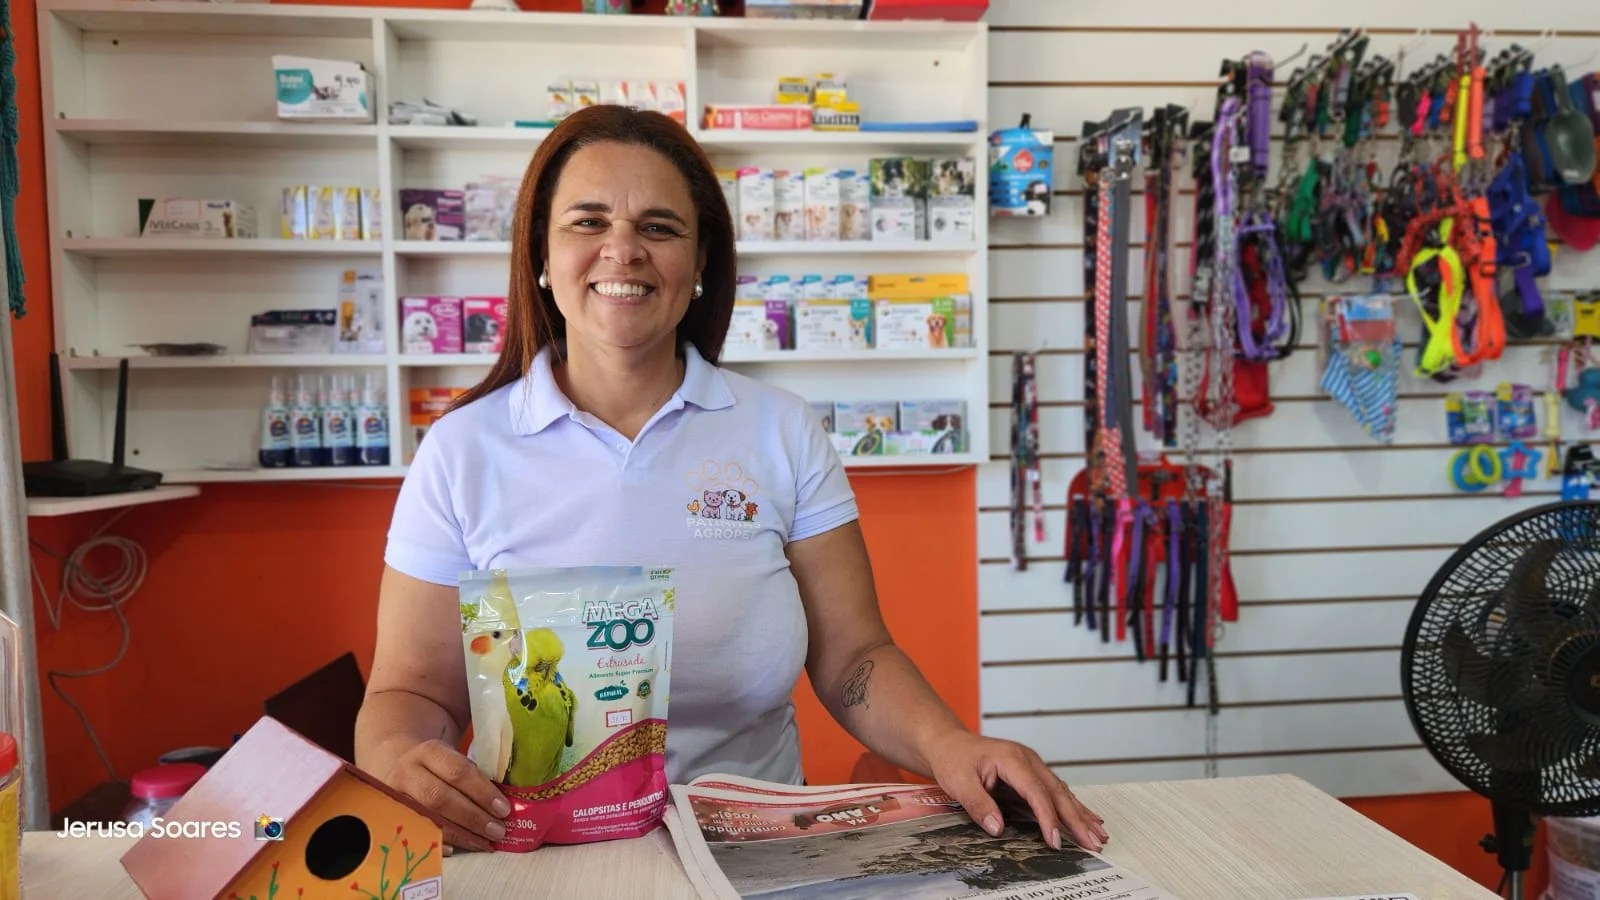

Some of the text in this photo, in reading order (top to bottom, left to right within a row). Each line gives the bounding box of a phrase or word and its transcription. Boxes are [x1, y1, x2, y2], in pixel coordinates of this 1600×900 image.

[581, 597, 659, 624] MEGA
[586, 618, 655, 652] ZOO
[572, 803, 621, 818] CALOPSITAS
[622, 802, 628, 811] E
[816, 808, 864, 824] ANO
[1044, 873, 1125, 895] ESPERANÇA
